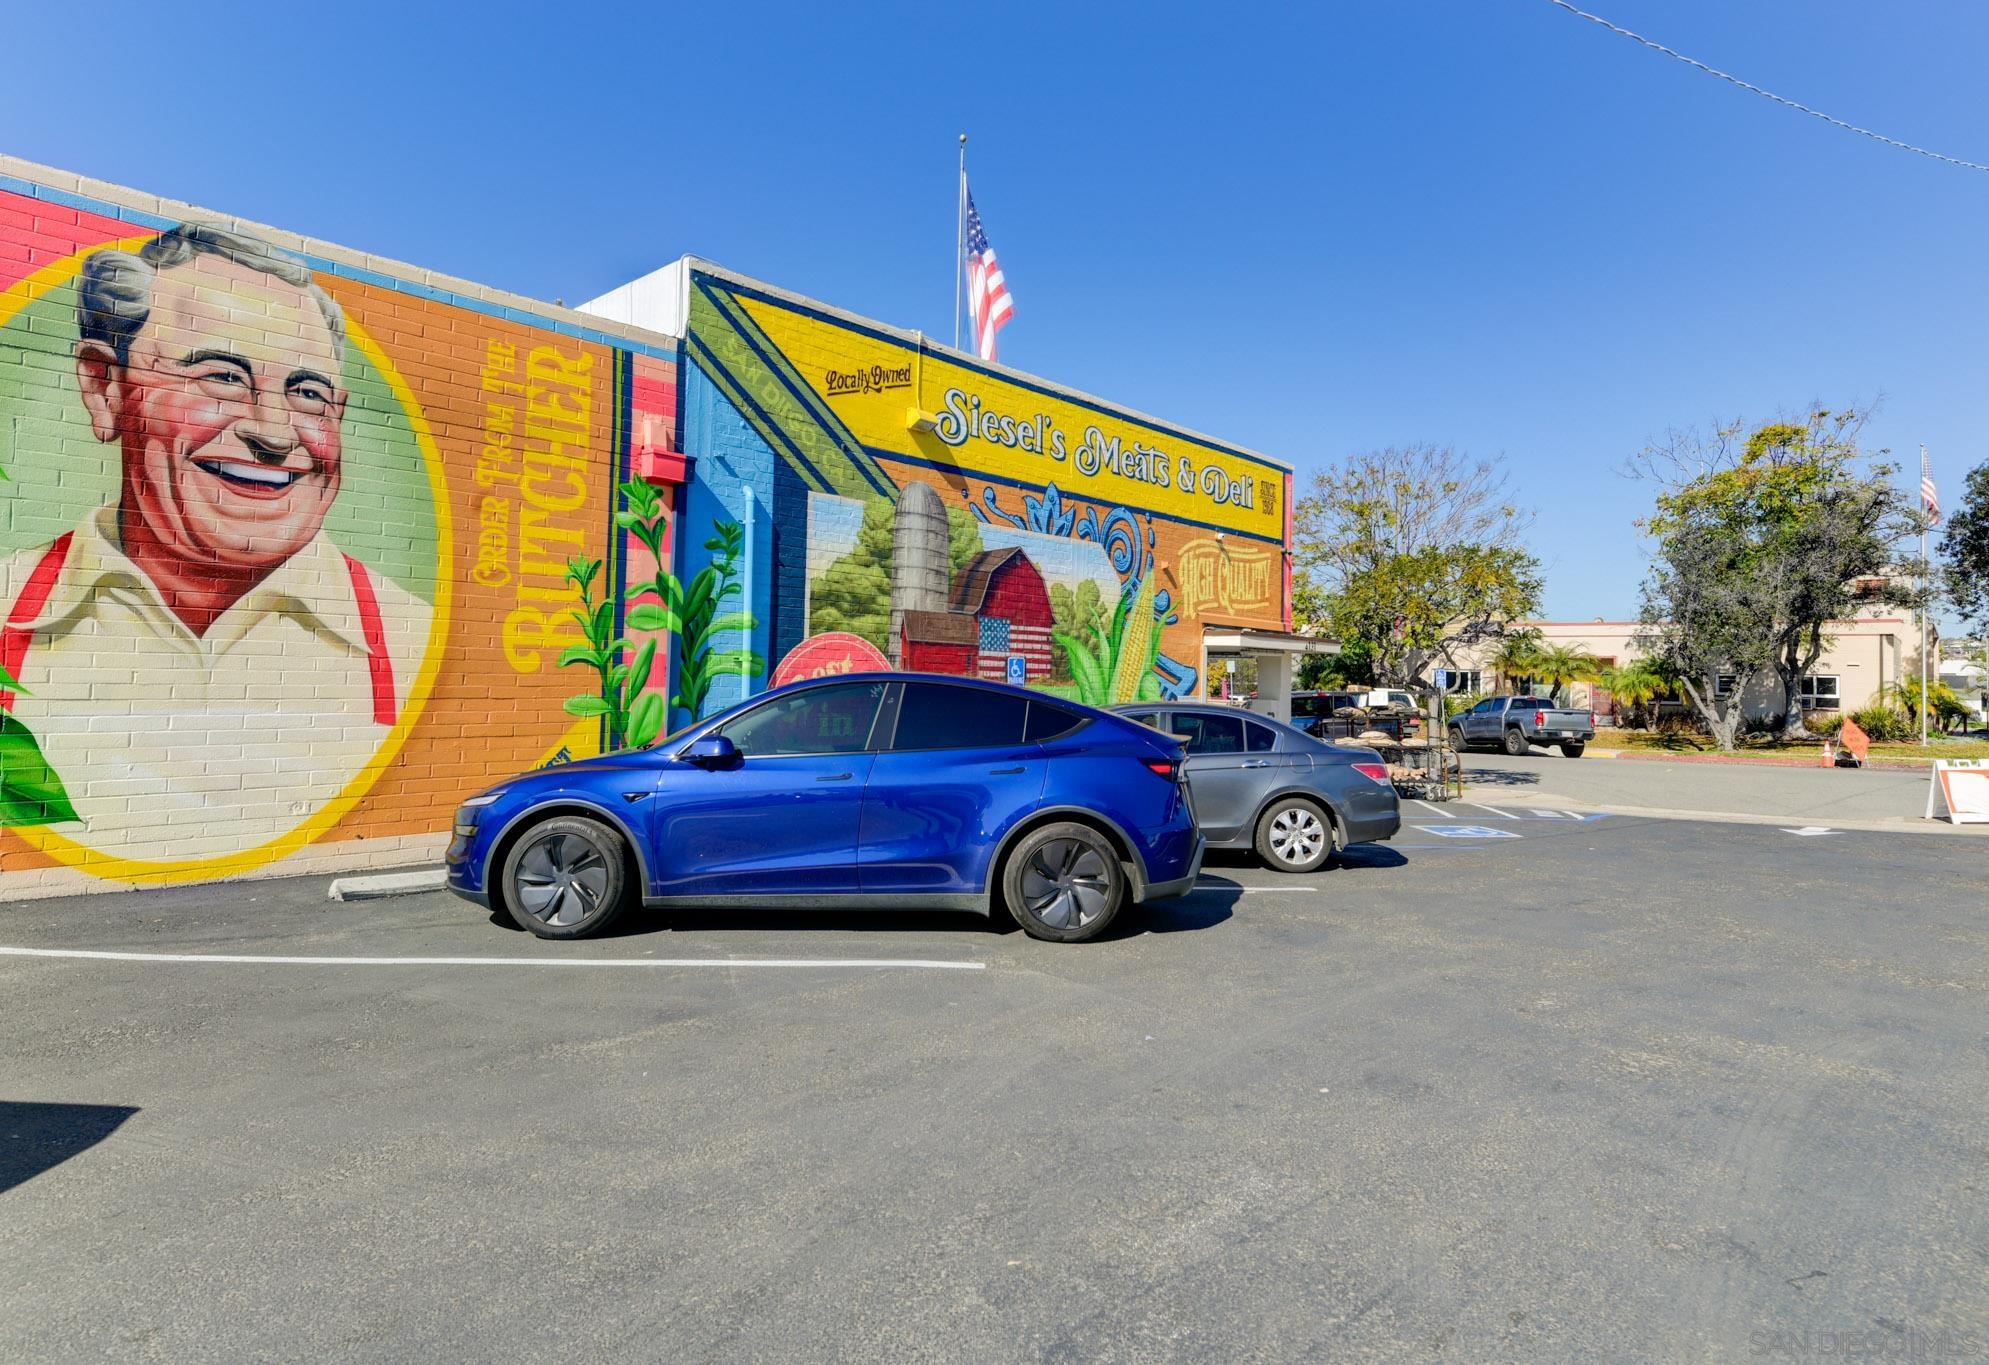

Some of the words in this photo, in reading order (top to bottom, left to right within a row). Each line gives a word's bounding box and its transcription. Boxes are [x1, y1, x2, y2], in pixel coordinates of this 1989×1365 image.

[481, 337, 524, 393] THE
[825, 369, 871, 394] Locally
[870, 363, 912, 385] Owned
[474, 401, 521, 488] FROM
[934, 387, 1067, 462] Siesel's
[1074, 425, 1170, 488] Meats
[1177, 456, 1197, 494] &
[1200, 465, 1255, 510] Deli
[472, 496, 512, 587] ORDER
[501, 345, 595, 674] BUTCHER
[1178, 551, 1214, 619] HIGH
[1217, 554, 1272, 616] QUALITY
